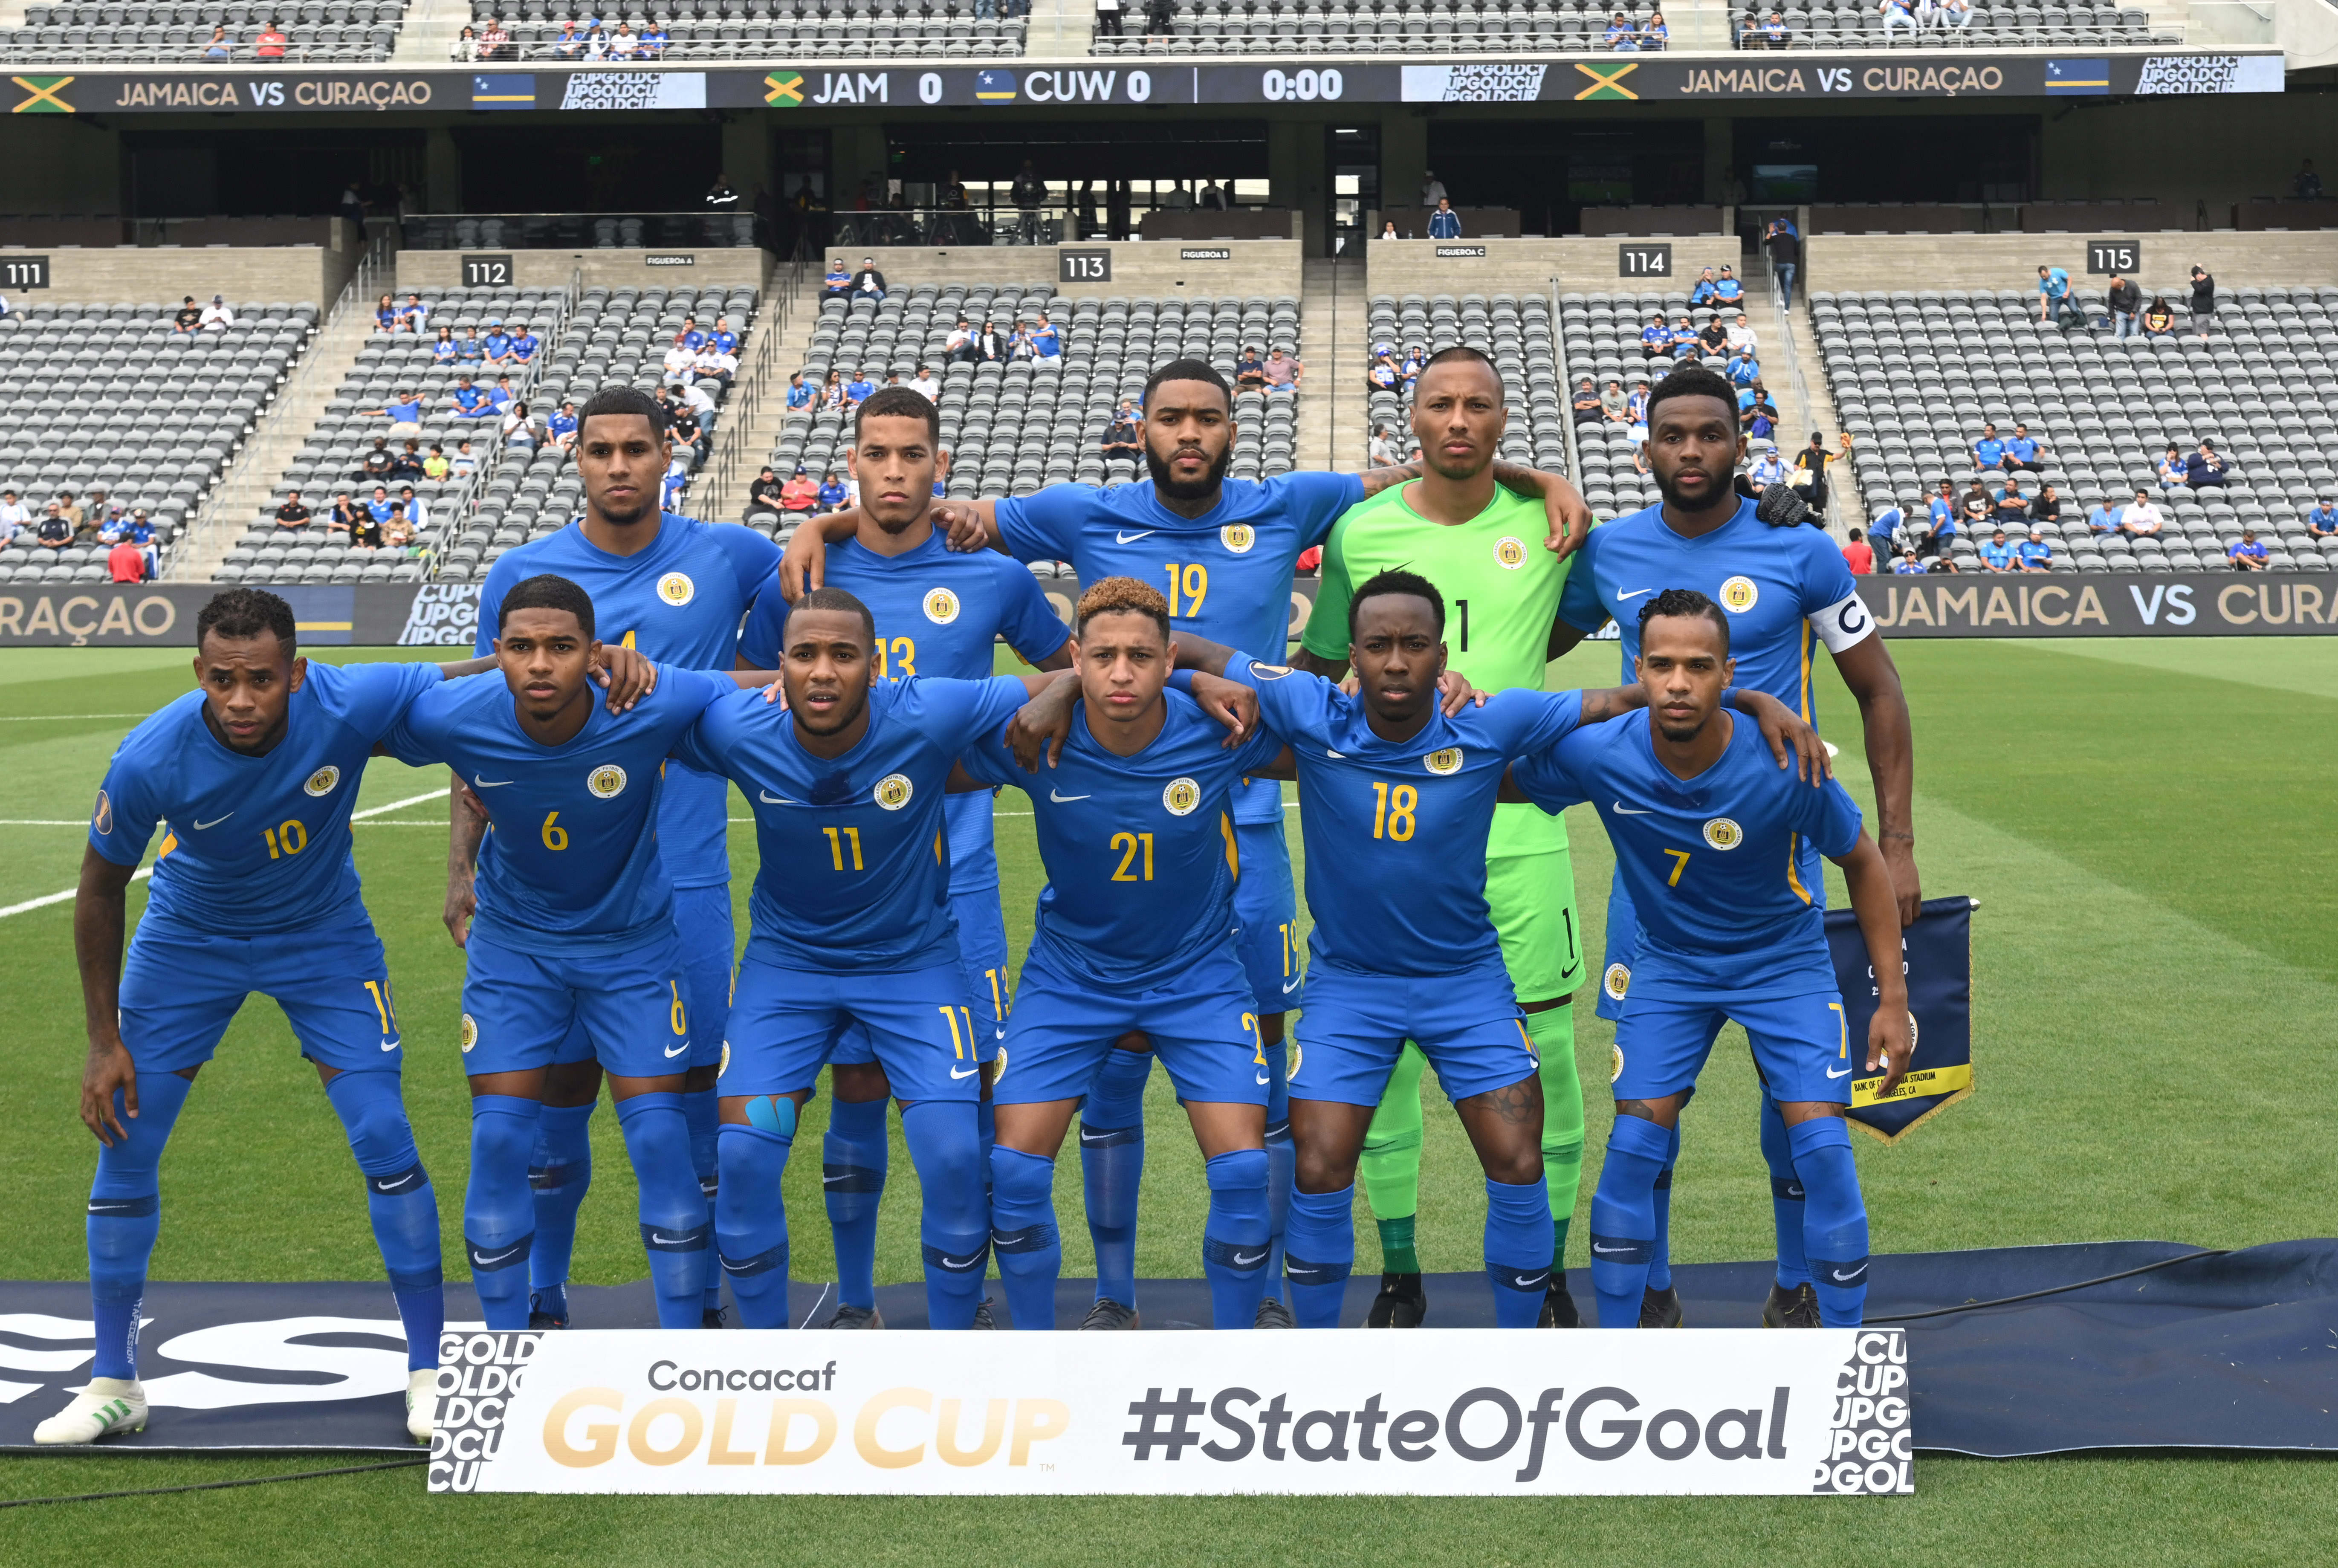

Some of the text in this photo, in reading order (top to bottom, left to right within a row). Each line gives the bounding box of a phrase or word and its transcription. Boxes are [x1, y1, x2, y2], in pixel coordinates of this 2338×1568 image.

[116, 81, 431, 111] JAMAICA VS CURAÇAO
[813, 72, 942, 103] JAM 0
[1025, 70, 1151, 102] CUW 0
[1262, 69, 1343, 100] 0:00
[1680, 67, 2003, 97] JAMAICA VS CURAÇAO
[7, 264, 40, 284] 111
[469, 263, 506, 283] 112
[1066, 257, 1104, 278] 113
[1627, 252, 1664, 272] 114
[2095, 249, 2132, 269] 115
[1165, 564, 1208, 617] 19
[1873, 586, 2110, 627] JAMAICA
[2128, 584, 2196, 627] VS
[1455, 599, 1468, 652] 1
[1838, 600, 1865, 634] C
[588, 769, 601, 794] FEDERASHON
[876, 780, 886, 807] FEDERASHON
[1164, 781, 1176, 810] FEDERASHON
[1372, 781, 1418, 842] 18
[259, 819, 307, 859] 10
[541, 811, 568, 851] 6
[1704, 819, 1741, 846] FEDERASHON FUTBOL KORSOU
[822, 827, 863, 871] 11
[1110, 832, 1153, 882] 21
[1664, 848, 1691, 888] 7
[1279, 918, 1299, 977] 19
[1562, 907, 1575, 960] 1
[1618, 965, 1630, 976] FUTBOL
[670, 980, 686, 1036] 6
[939, 1006, 978, 1062] 11
[1241, 1012, 1267, 1067] 2
[1828, 1002, 1846, 1059] 7
[1854, 1082, 1868, 1092] BANC
[1869, 1080, 1876, 1089] OF
[1910, 1071, 1936, 1083] STADIUM
[1908, 1085, 1916, 1094] CA
[647, 1360, 836, 1392] Concacaf
[542, 1386, 839, 1469] GOLD
[853, 1386, 1071, 1470] CUP
[1122, 1386, 1790, 1482] #StateOfGoal
